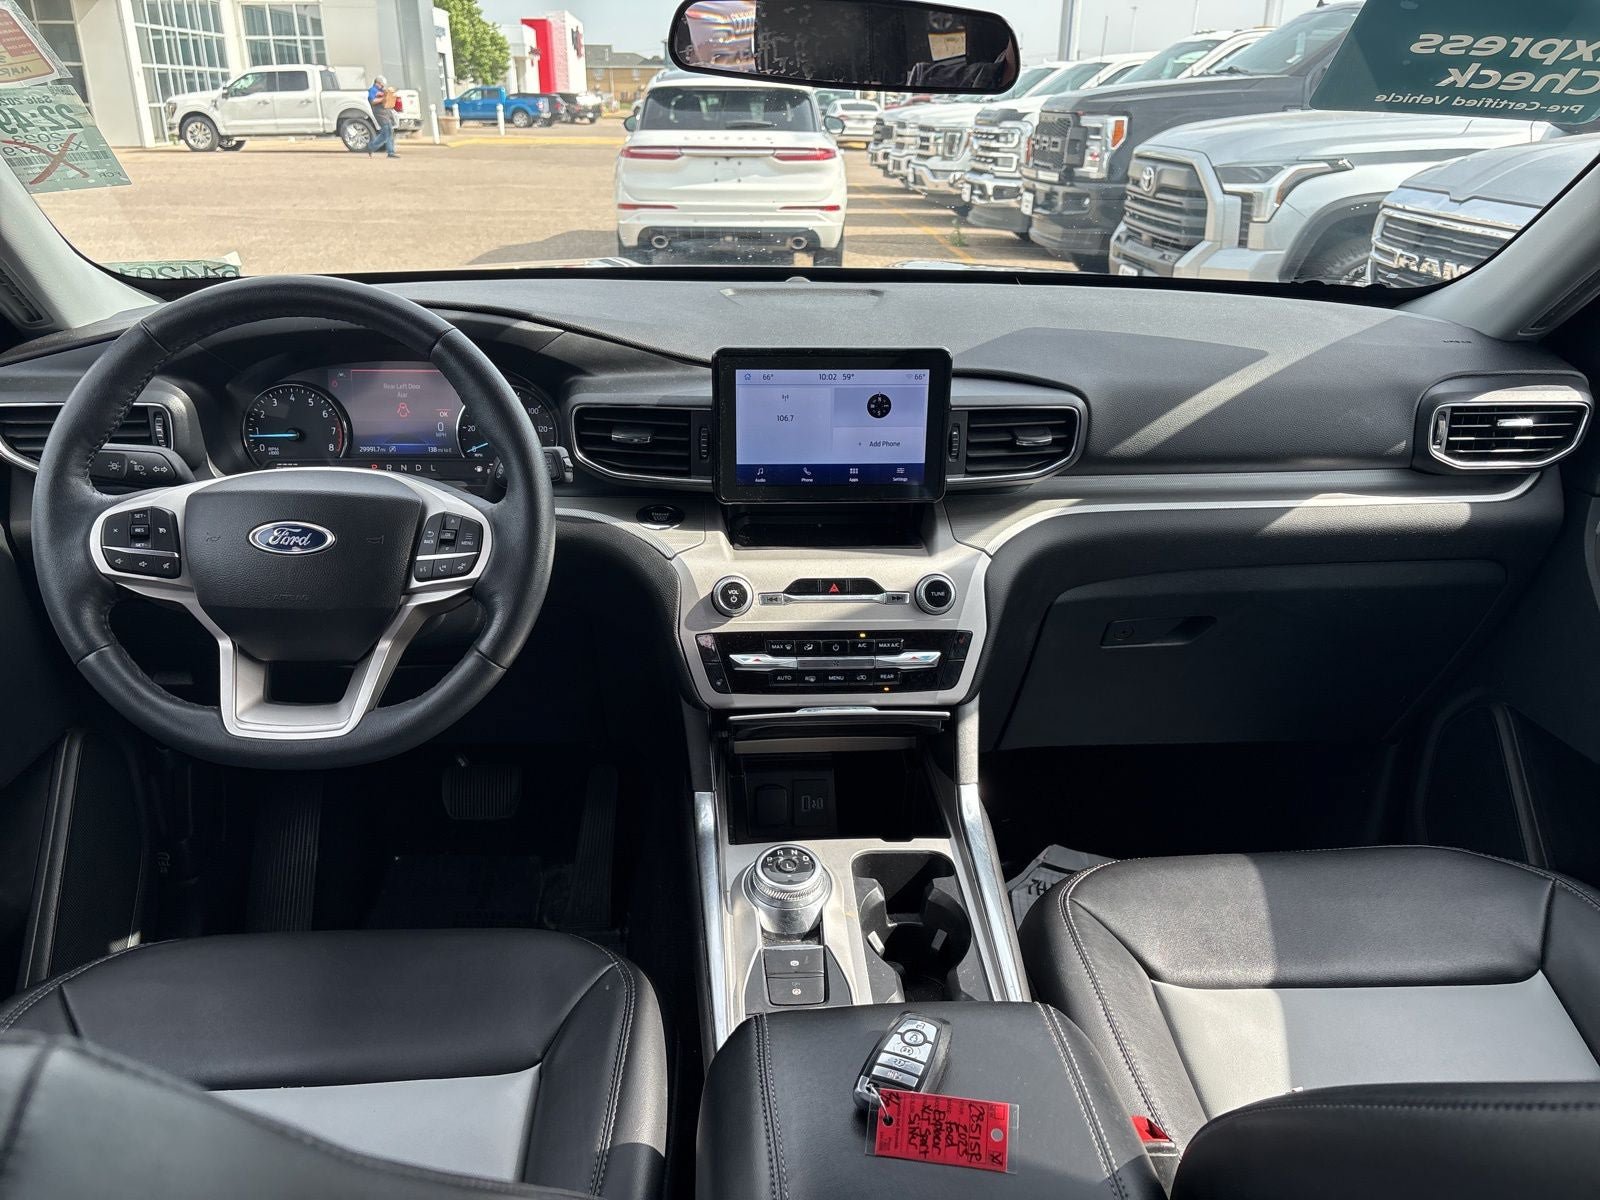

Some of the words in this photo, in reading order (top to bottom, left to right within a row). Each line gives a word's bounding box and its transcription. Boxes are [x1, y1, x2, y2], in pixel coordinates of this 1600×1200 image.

[437, 421, 444, 432] 0
[400, 464, 407, 472] N
[415, 464, 422, 472] D
[430, 464, 436, 472] L
[268, 527, 312, 546] Ford
